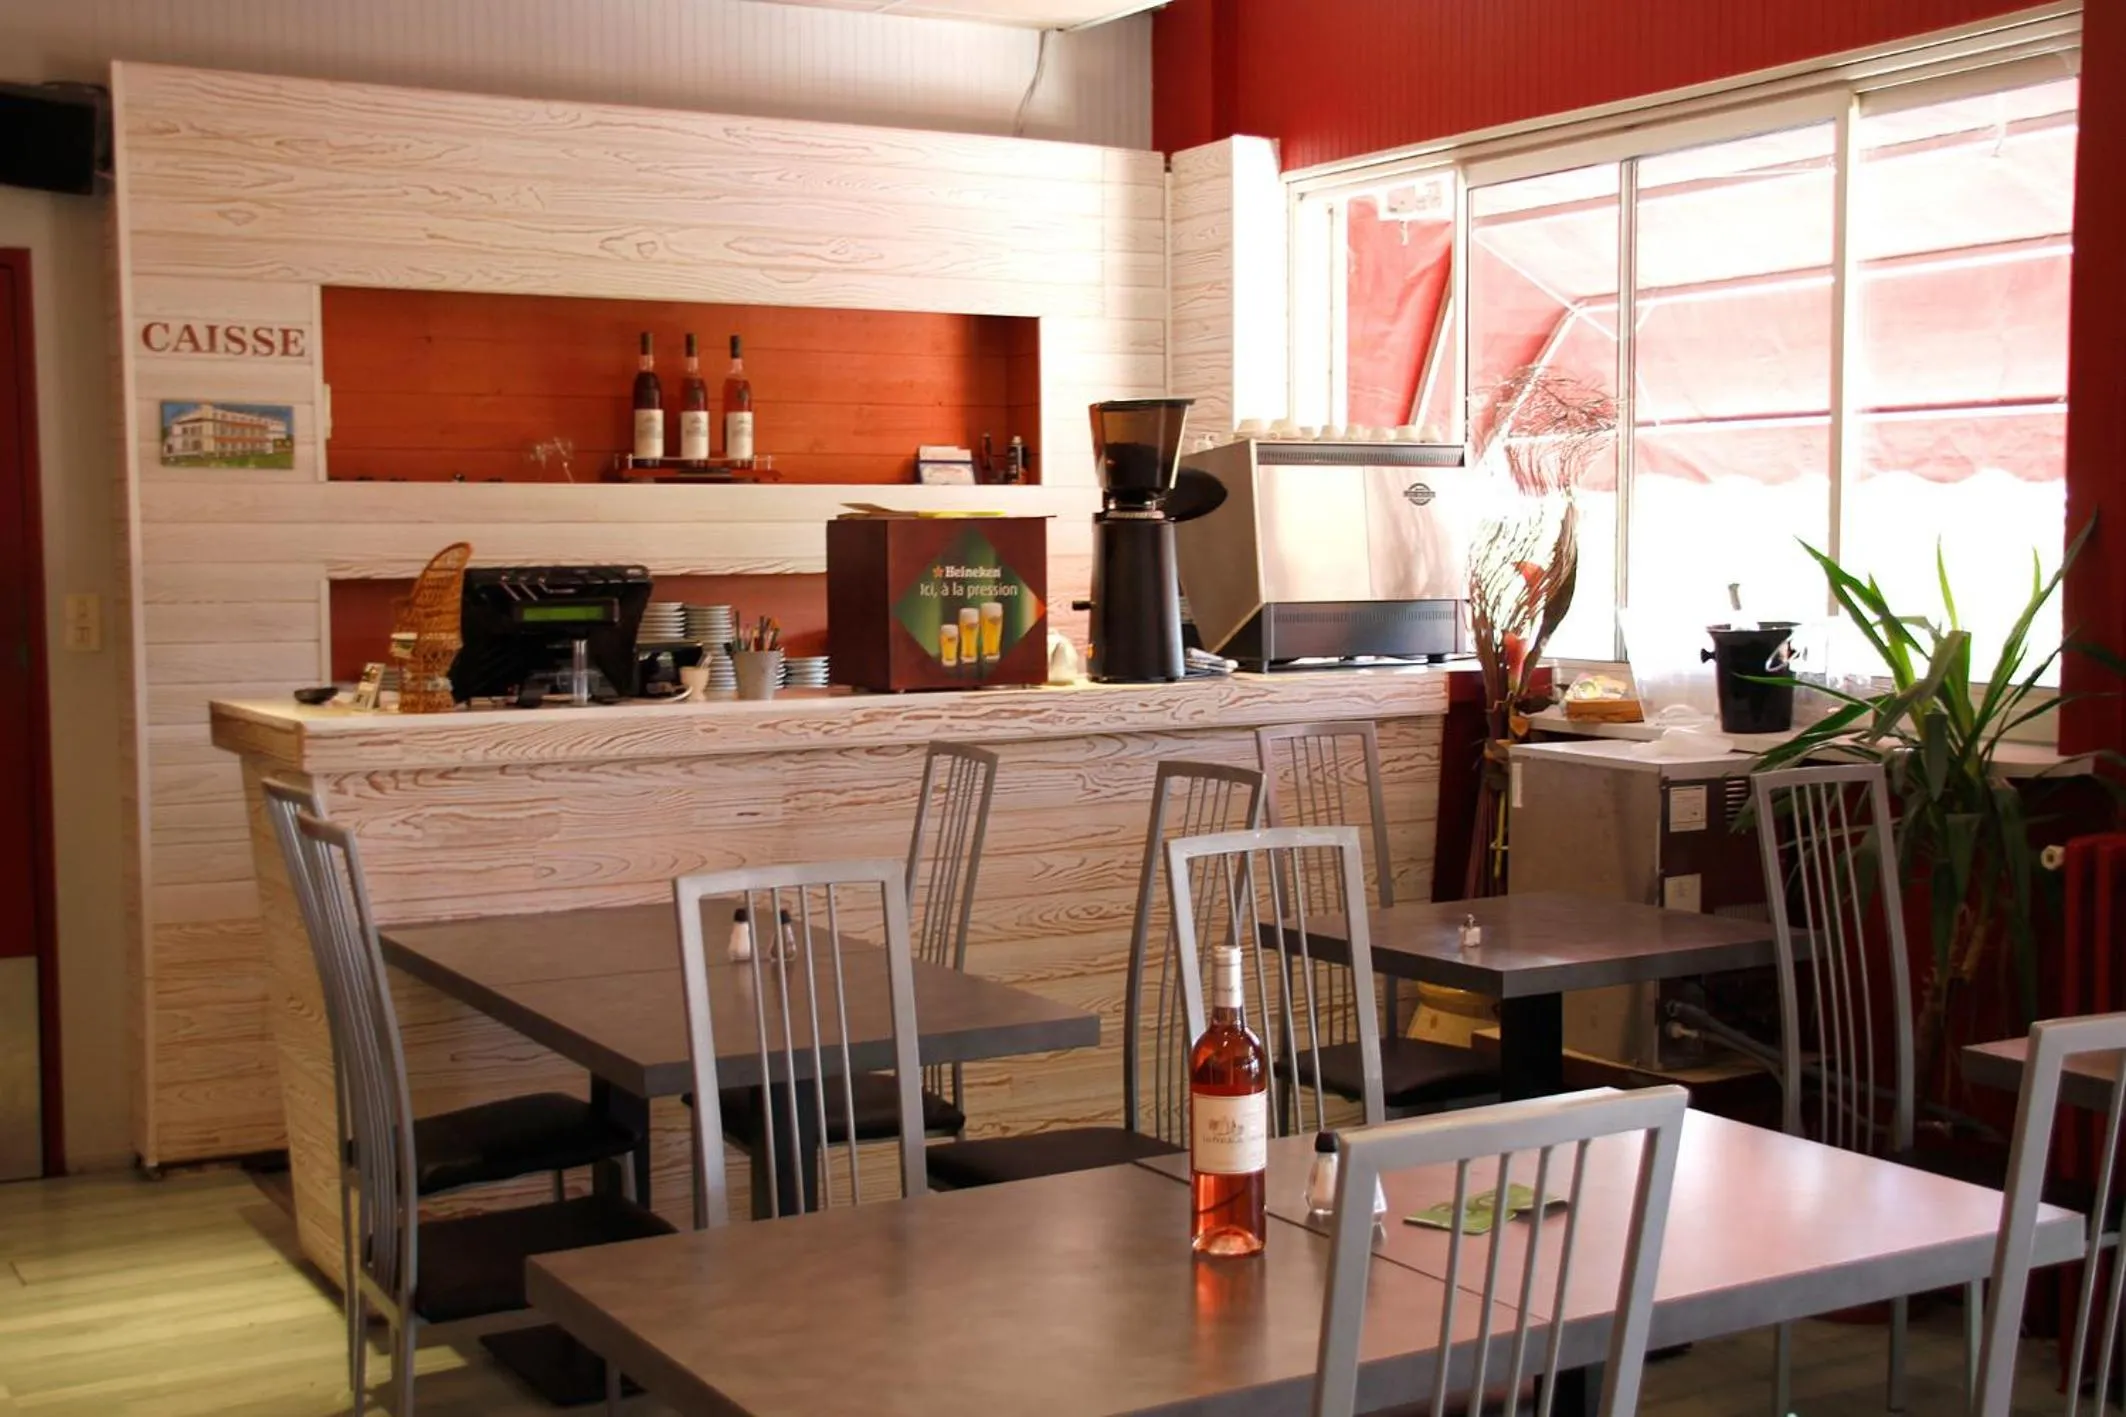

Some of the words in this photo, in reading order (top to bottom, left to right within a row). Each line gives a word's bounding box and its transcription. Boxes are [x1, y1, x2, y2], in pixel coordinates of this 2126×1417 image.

[141, 321, 306, 357] CAISSE
[945, 565, 1002, 578] Heineken
[920, 583, 938, 598] Ici,
[941, 582, 949, 597] à
[953, 581, 964, 597] la
[967, 583, 1018, 600] pression
